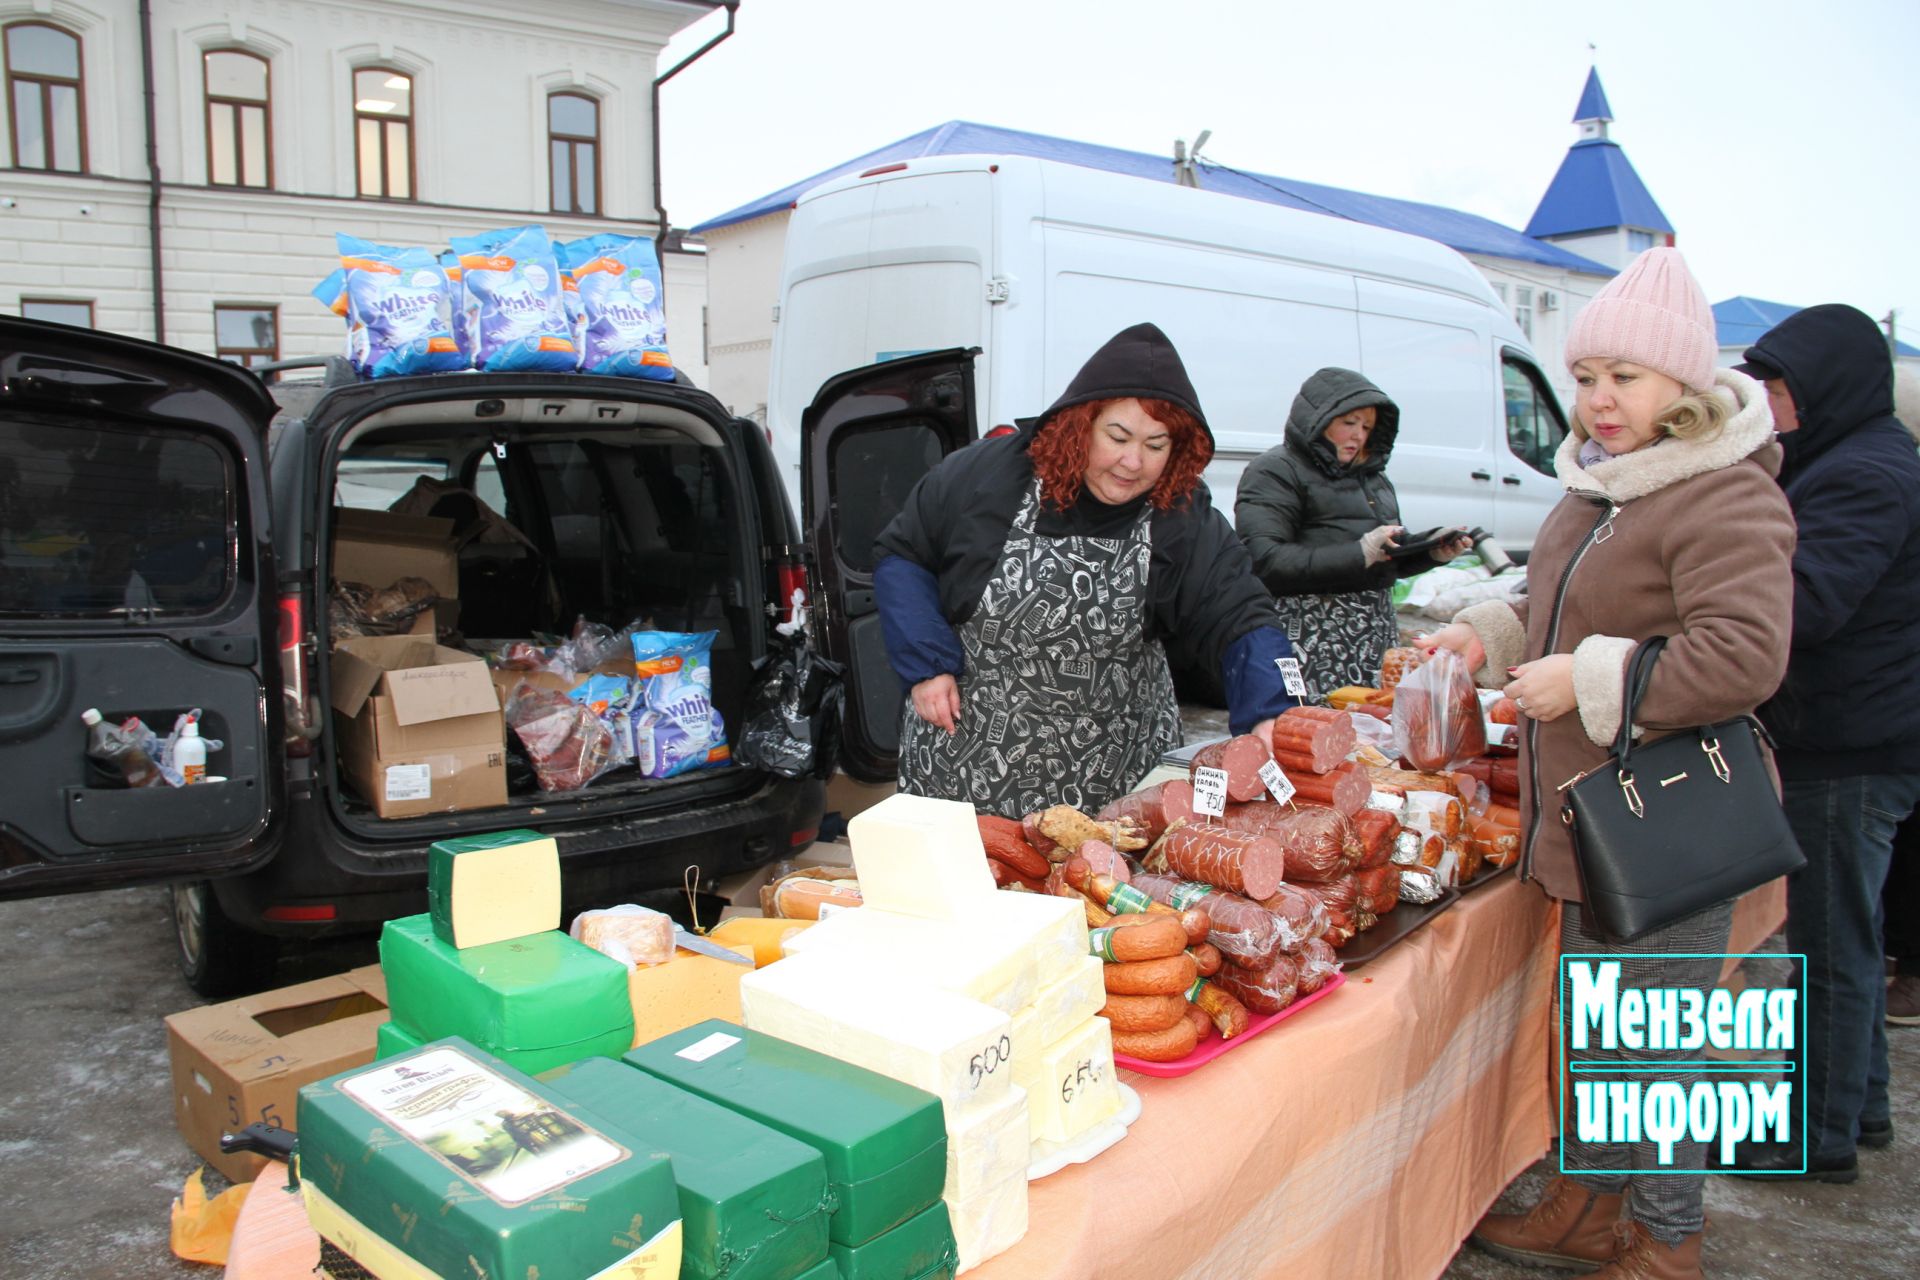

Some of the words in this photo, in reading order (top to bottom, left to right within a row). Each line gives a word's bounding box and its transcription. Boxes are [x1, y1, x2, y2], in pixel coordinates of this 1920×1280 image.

[666, 694, 709, 718] whit
[682, 714, 708, 725] FEATHE
[1206, 792, 1225, 812] 750
[969, 1034, 1010, 1090] 500
